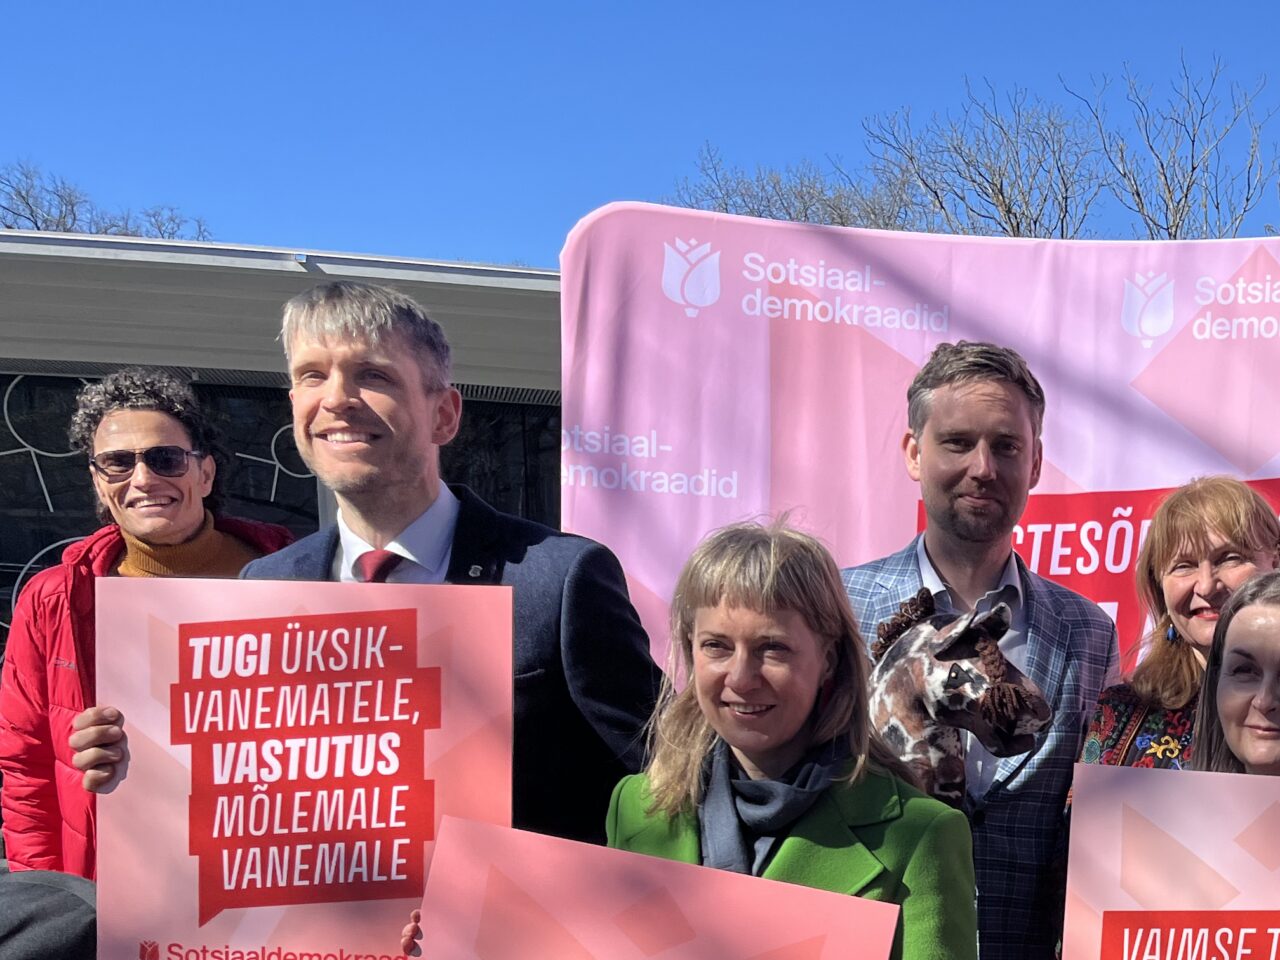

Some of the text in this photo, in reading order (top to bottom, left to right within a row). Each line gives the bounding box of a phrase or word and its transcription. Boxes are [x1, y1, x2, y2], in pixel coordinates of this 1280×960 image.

[741, 252, 886, 292] Sotsiaal-
[741, 288, 950, 333] demokraadid
[189, 623, 403, 680] TUGI ÜKSIK-
[184, 678, 421, 734] VANEMATELE,
[212, 732, 401, 785] VASTUTUS
[212, 783, 410, 839] MÕLEMALE
[222, 839, 411, 891] VANEMALE
